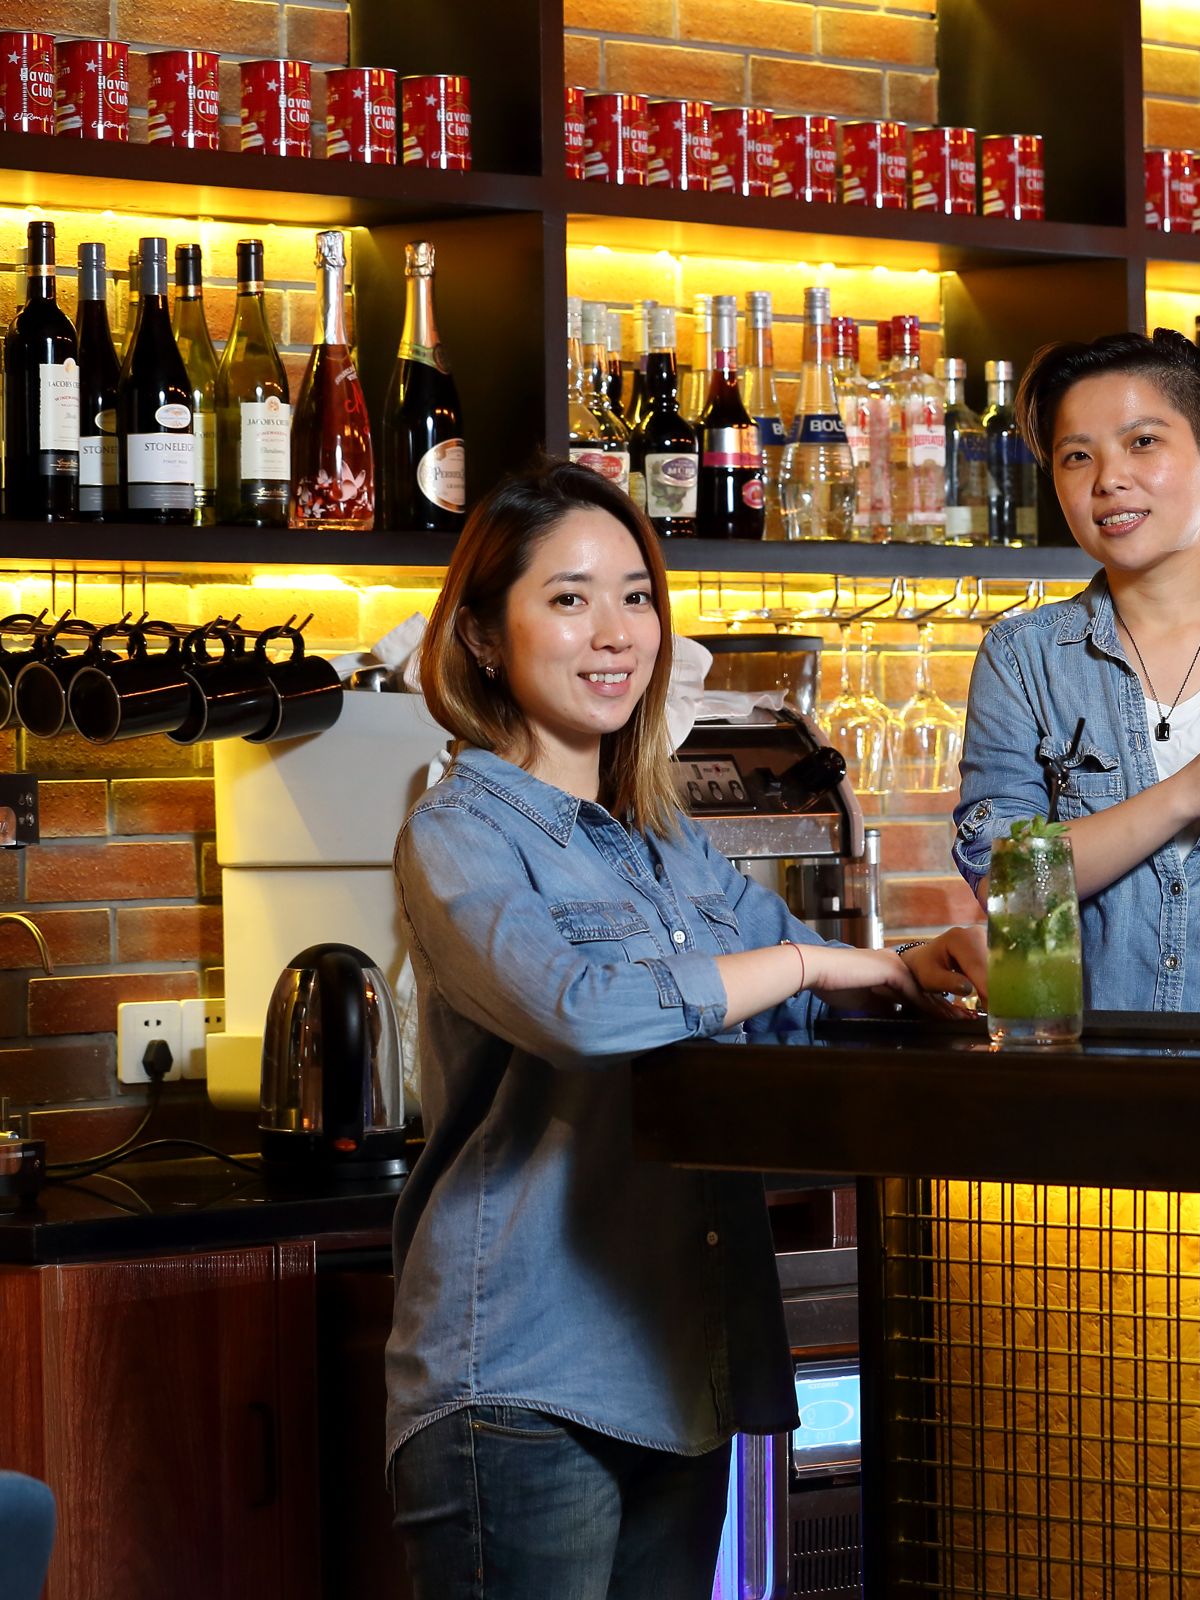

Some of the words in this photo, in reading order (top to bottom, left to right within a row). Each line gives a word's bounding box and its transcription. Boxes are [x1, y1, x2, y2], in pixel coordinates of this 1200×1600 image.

[20, 67, 55, 83] Havan
[31, 83, 53, 97] Club
[98, 75, 129, 91] Havan
[109, 92, 128, 105] Club
[188, 85, 219, 101] Havan
[199, 101, 218, 115] Club
[279, 94, 311, 109] Havan
[364, 101, 396, 116] Havan
[289, 109, 309, 123] Club
[437, 109, 471, 122] Havan
[374, 116, 395, 130] Club
[447, 123, 469, 136] Club
[810, 419, 845, 432] BOLS
[83, 445, 117, 455] STONE
